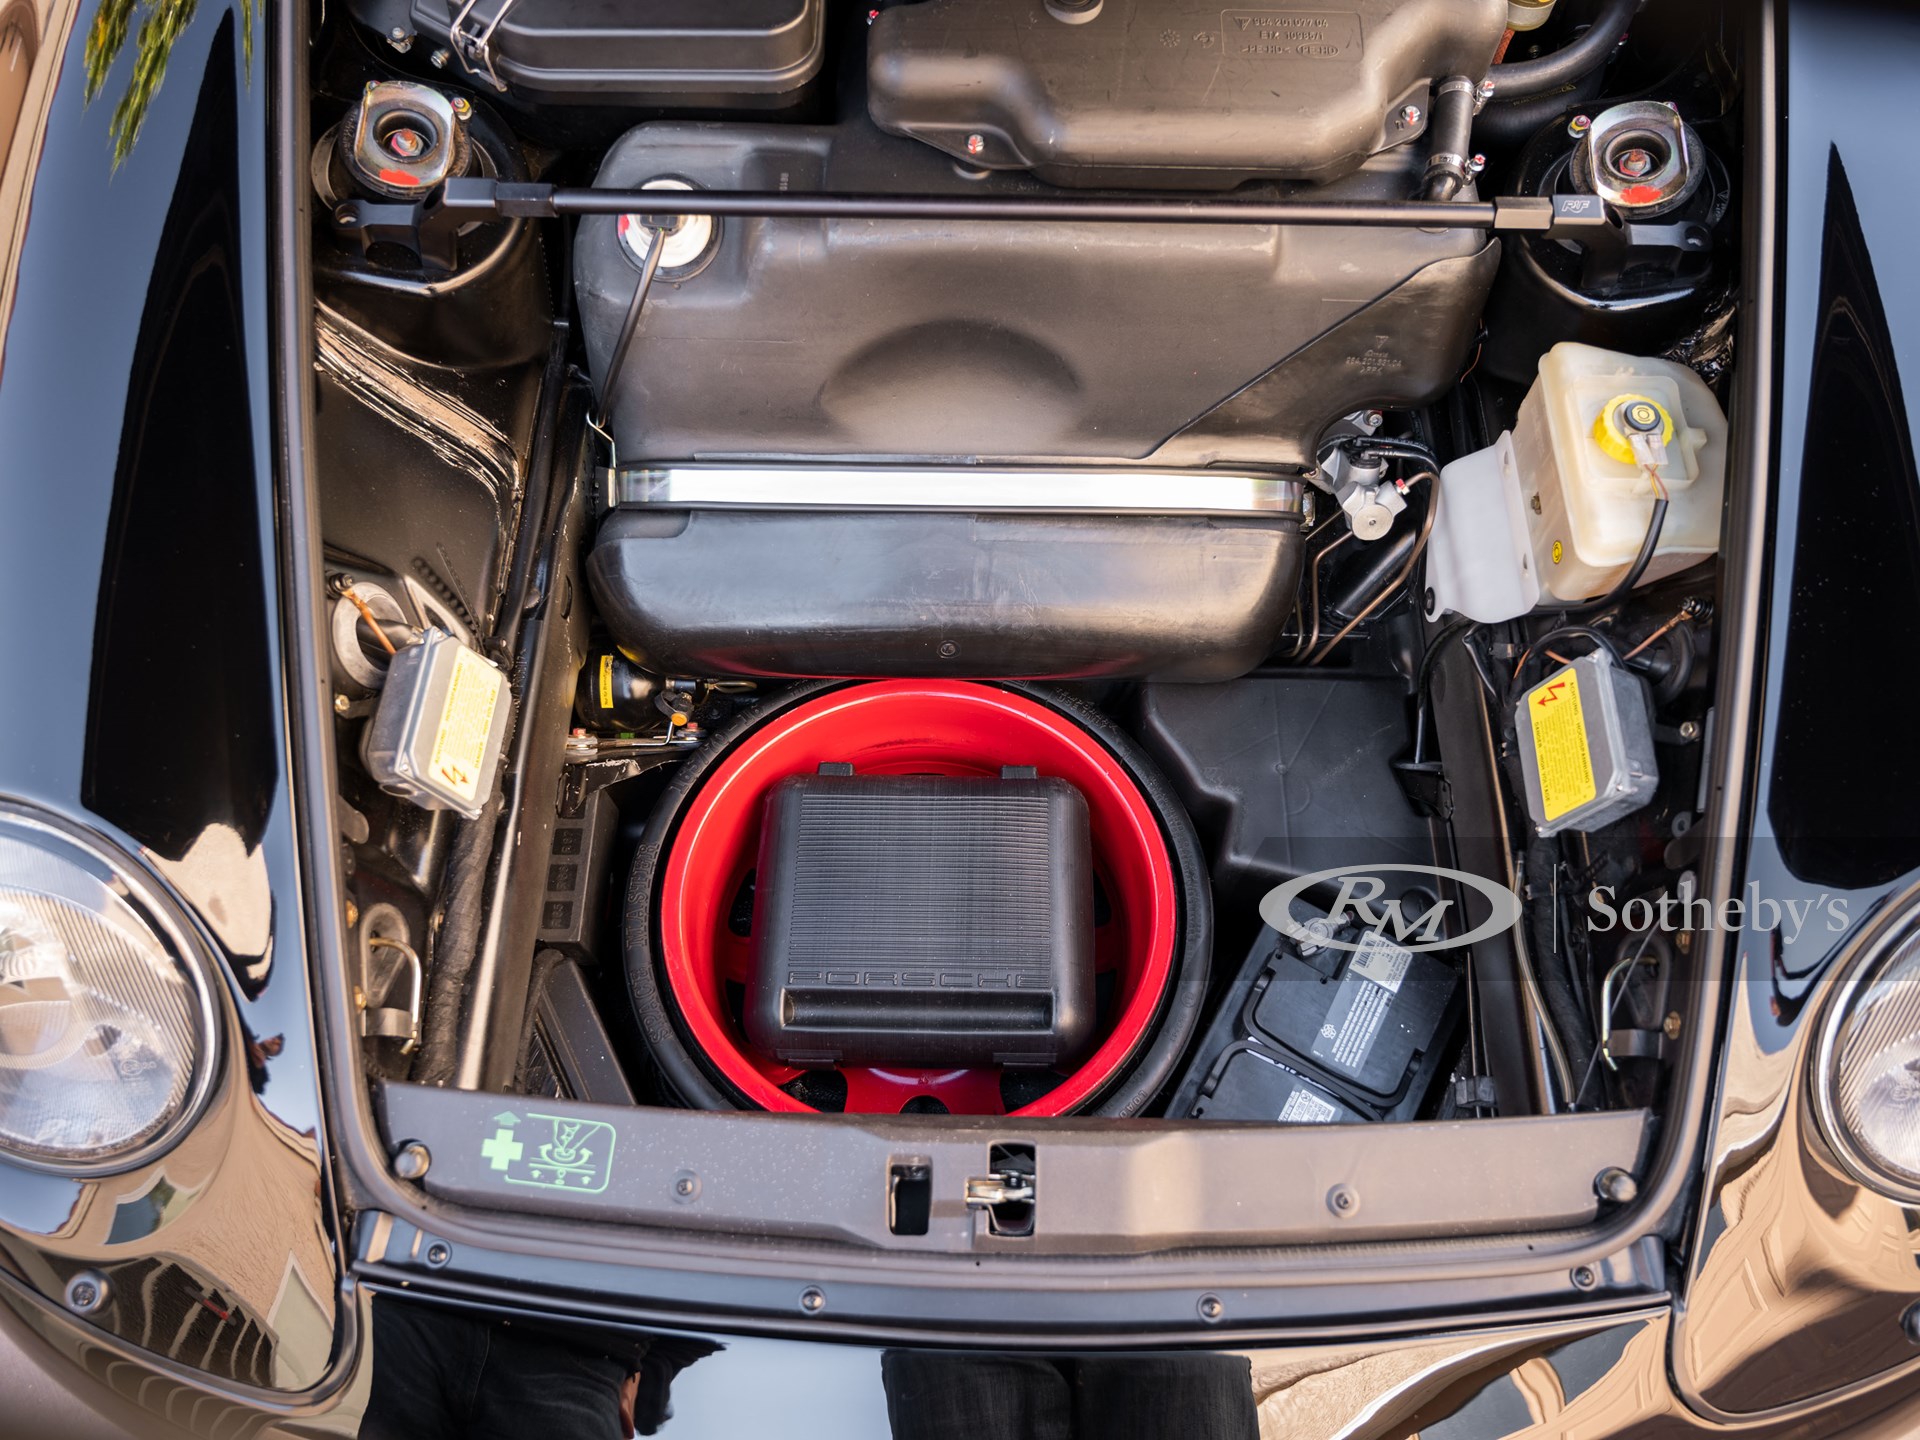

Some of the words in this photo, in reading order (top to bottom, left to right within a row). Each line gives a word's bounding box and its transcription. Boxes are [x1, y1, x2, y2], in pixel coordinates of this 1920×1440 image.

[626, 843, 659, 950] MASTER
[630, 964, 673, 1045] SPACE
[788, 971, 1050, 988] PORSCHE
